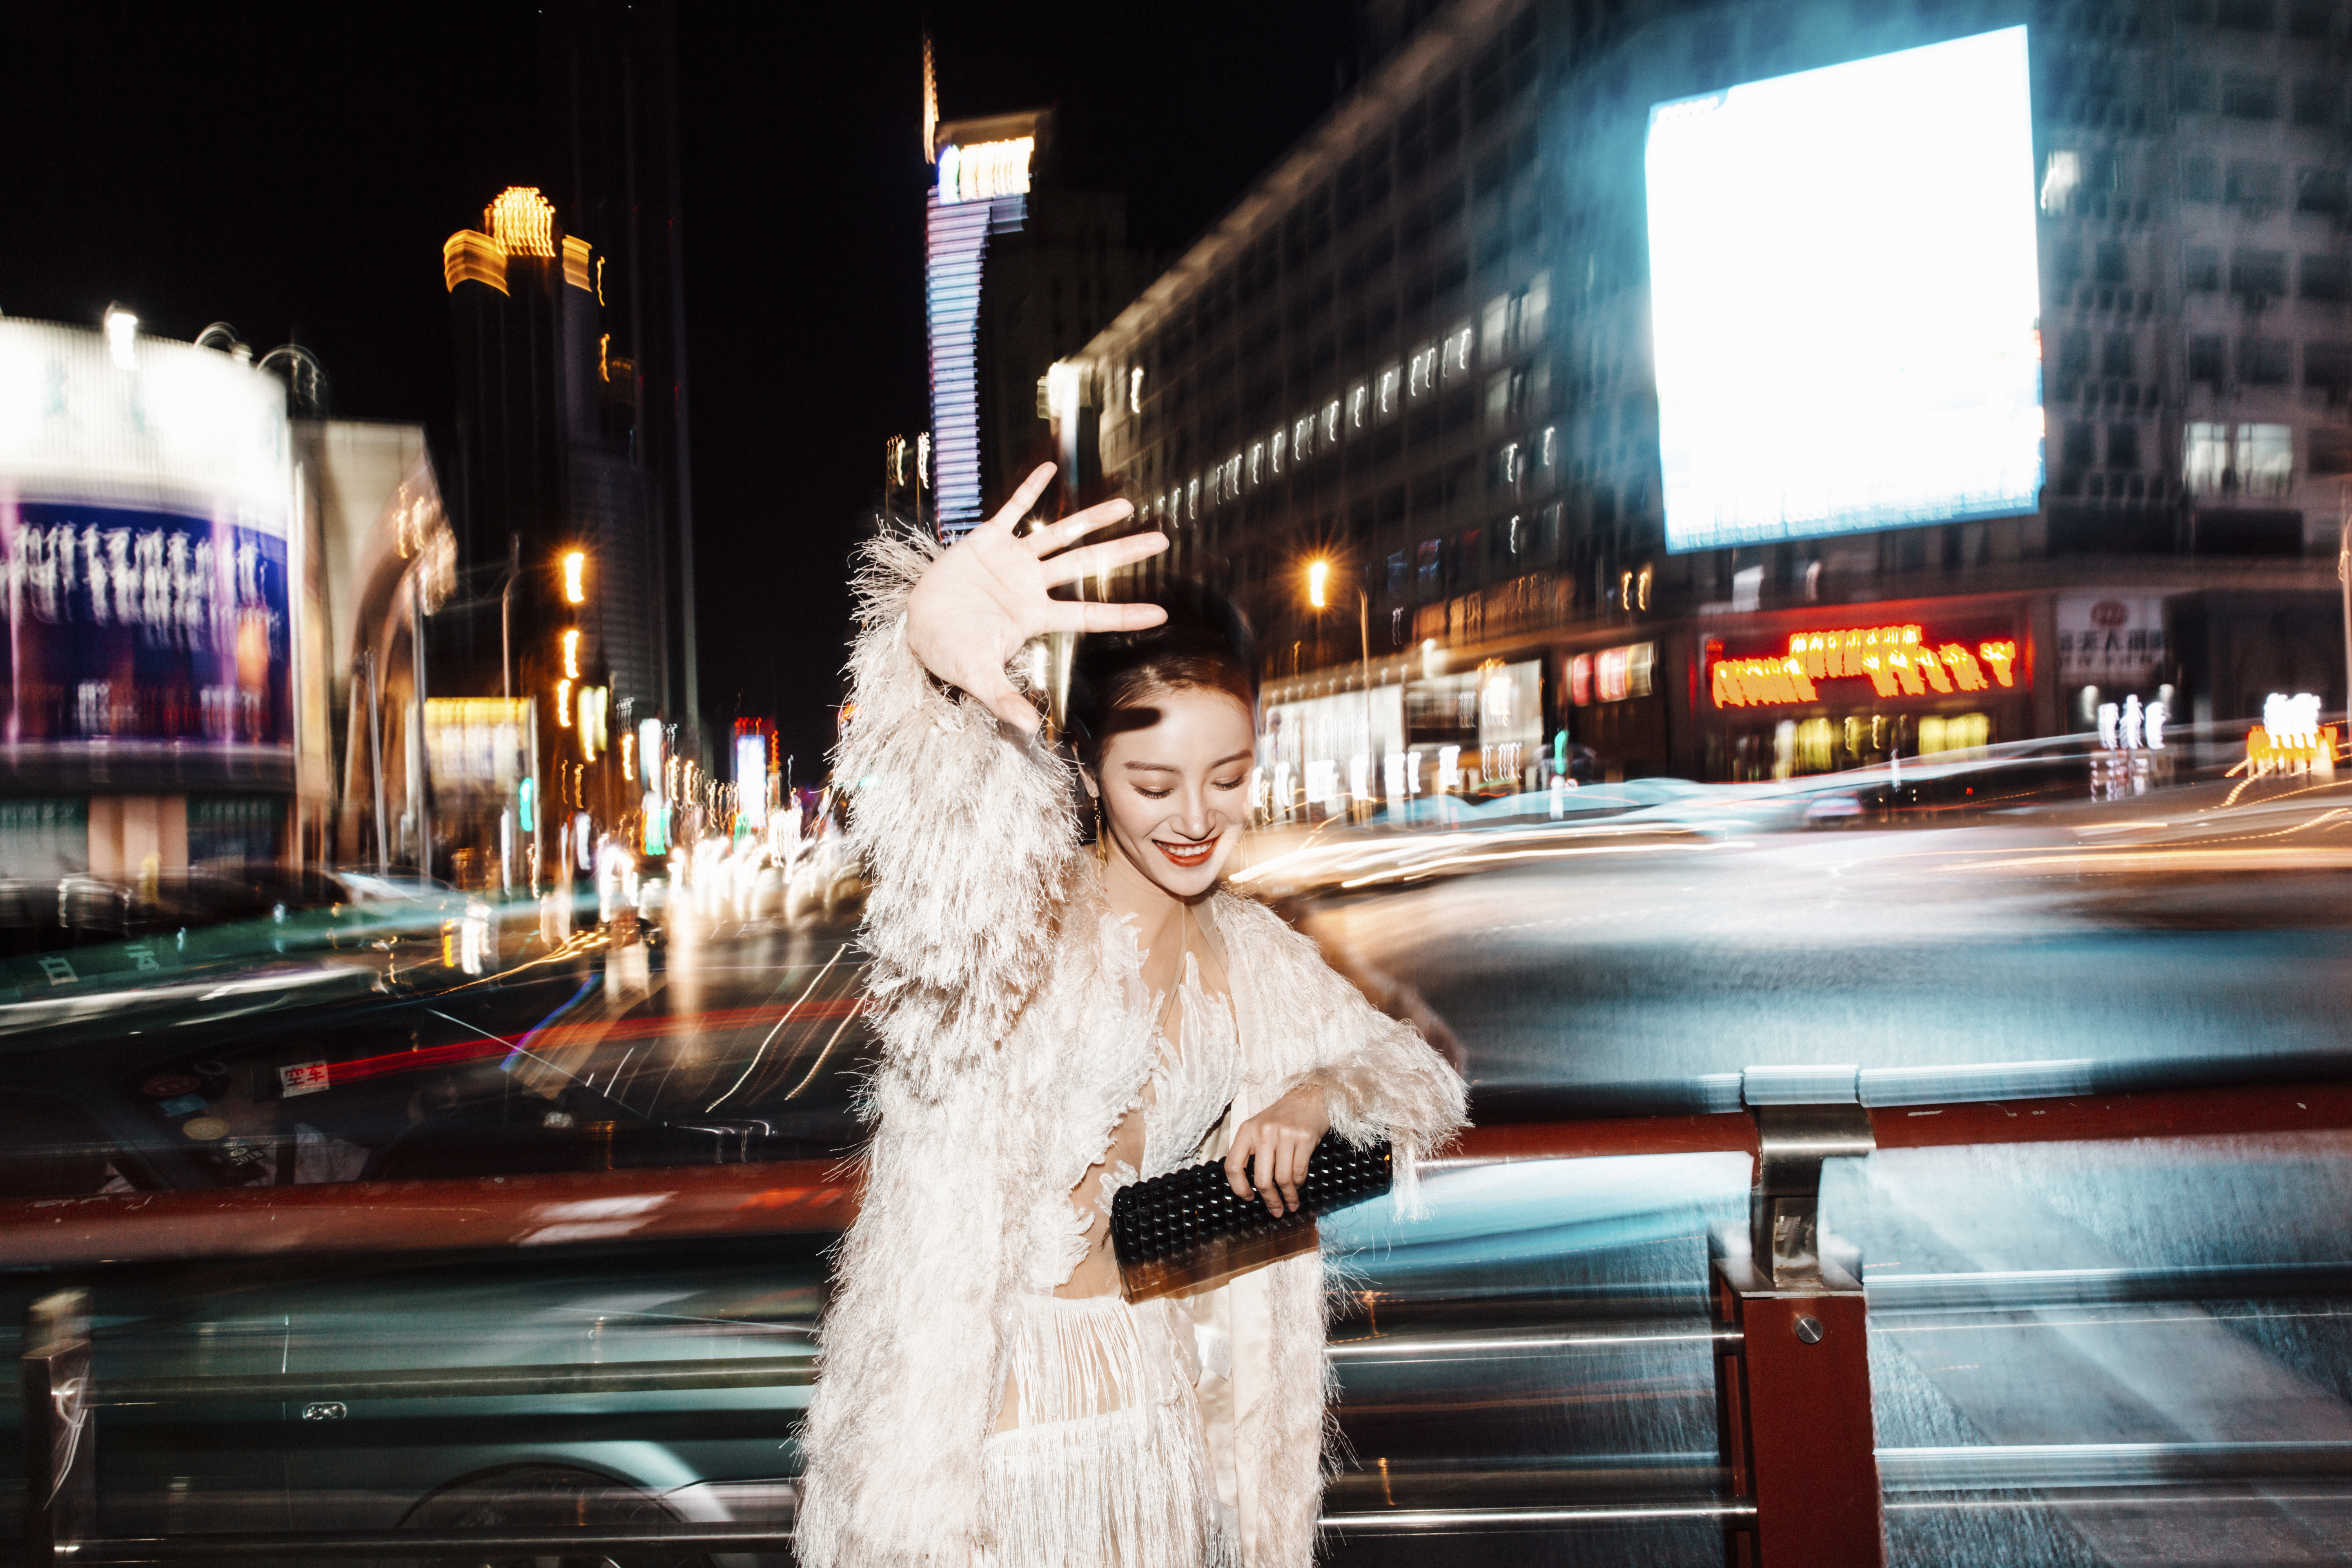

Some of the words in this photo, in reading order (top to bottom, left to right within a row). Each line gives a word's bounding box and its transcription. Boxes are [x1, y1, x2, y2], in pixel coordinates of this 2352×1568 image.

[38, 944, 160, 986] 白云
[285, 1065, 325, 1087] 空车
[231, 1150, 263, 1166] 2018
